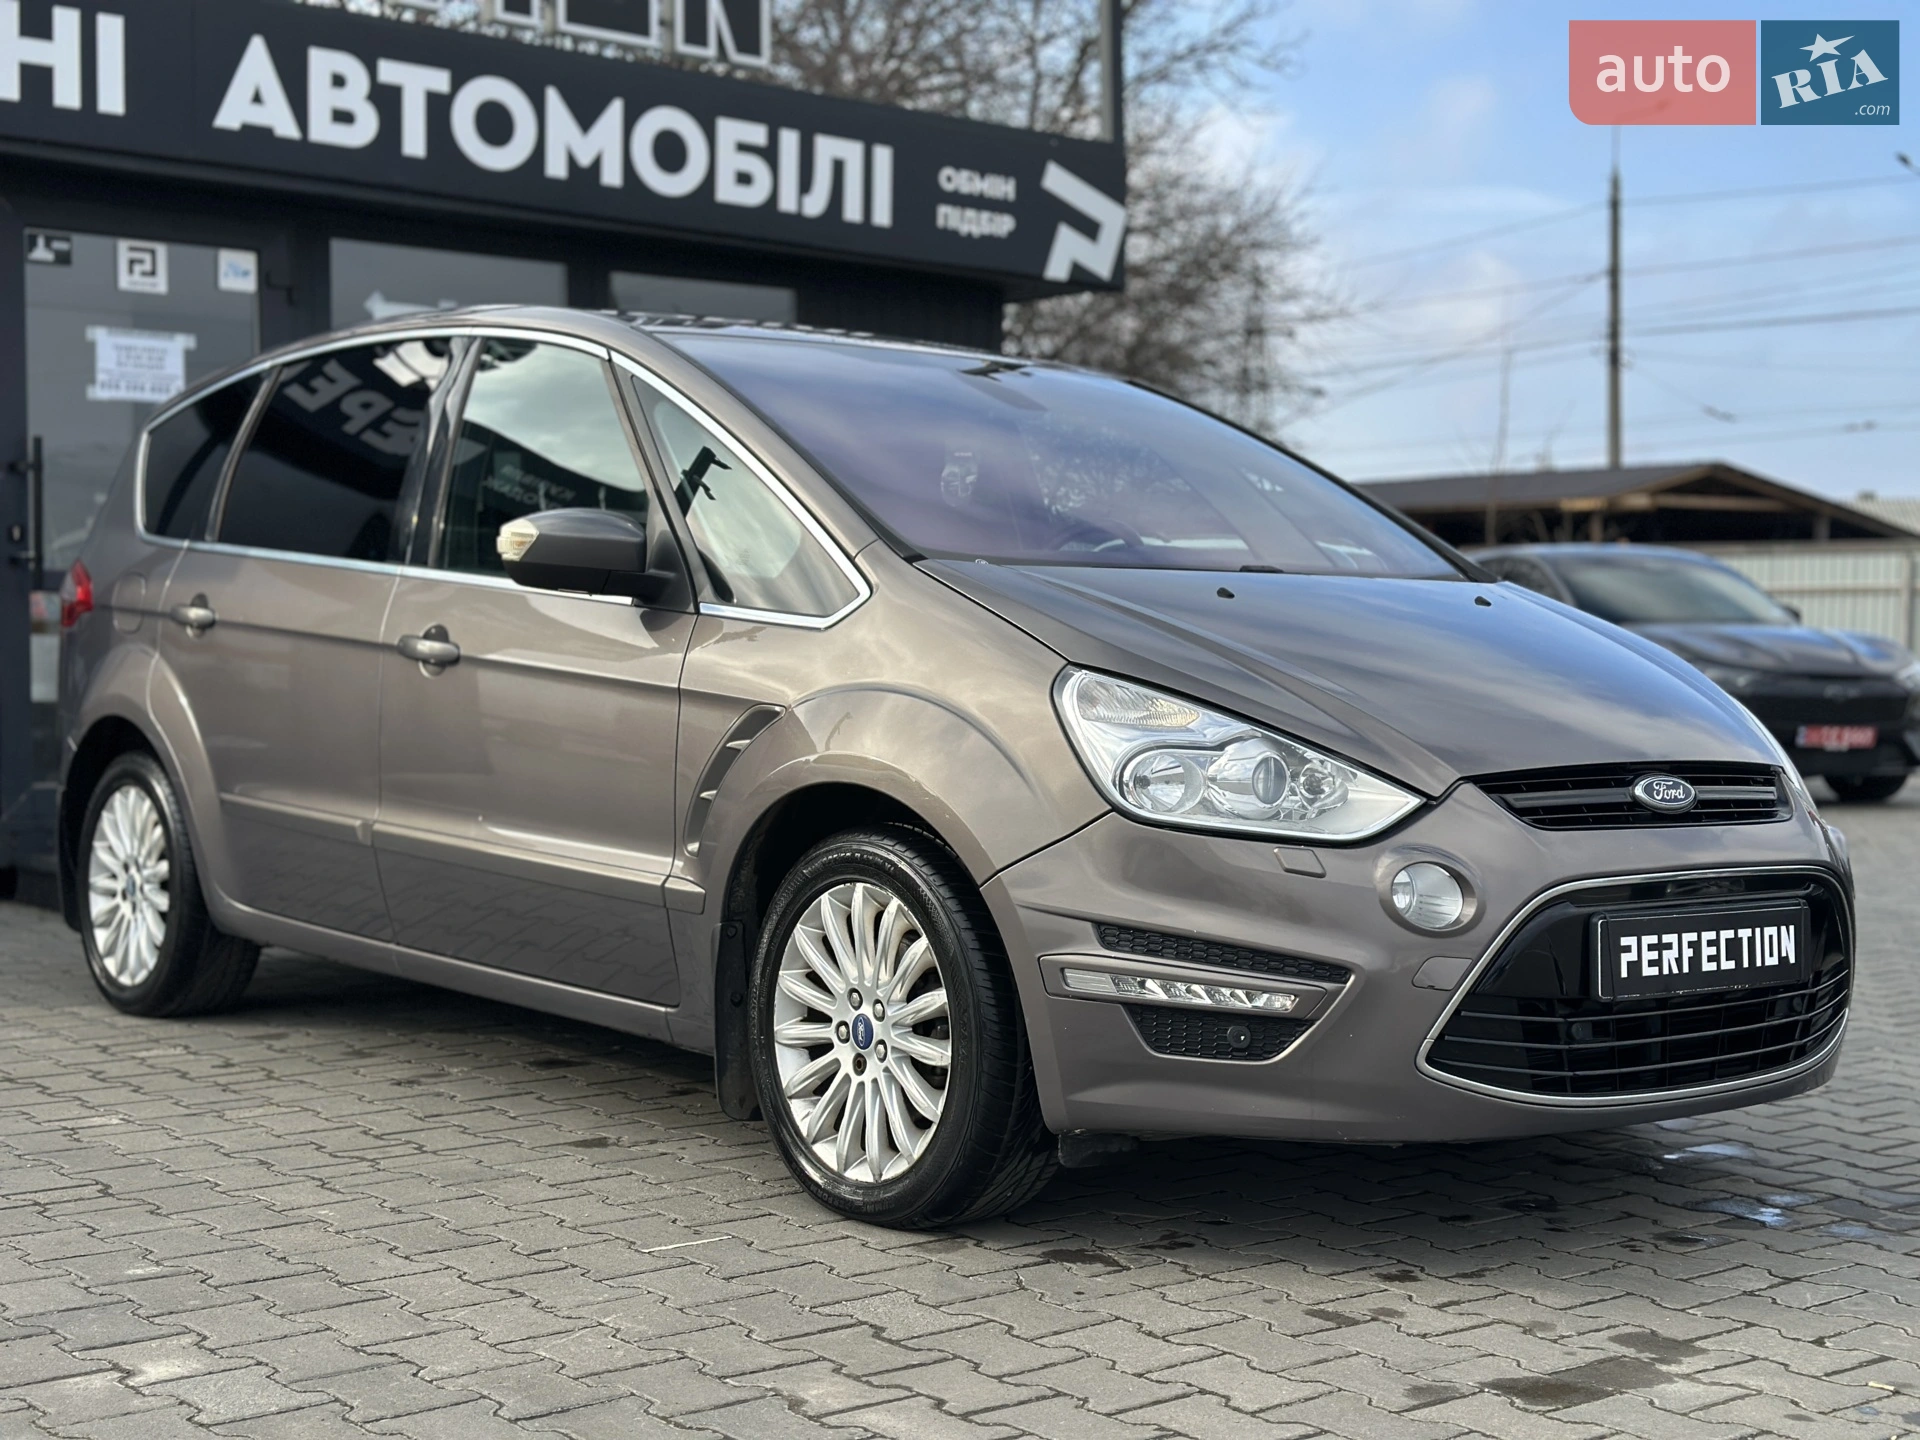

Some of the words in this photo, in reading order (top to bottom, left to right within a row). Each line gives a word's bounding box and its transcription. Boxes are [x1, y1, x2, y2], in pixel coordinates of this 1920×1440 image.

[212, 34, 893, 228] АВТОМОБІЛІ
[936, 164, 1017, 203] ОБМІН
[1652, 779, 1686, 801] Ford
[1619, 924, 1796, 979] PERFECTION
